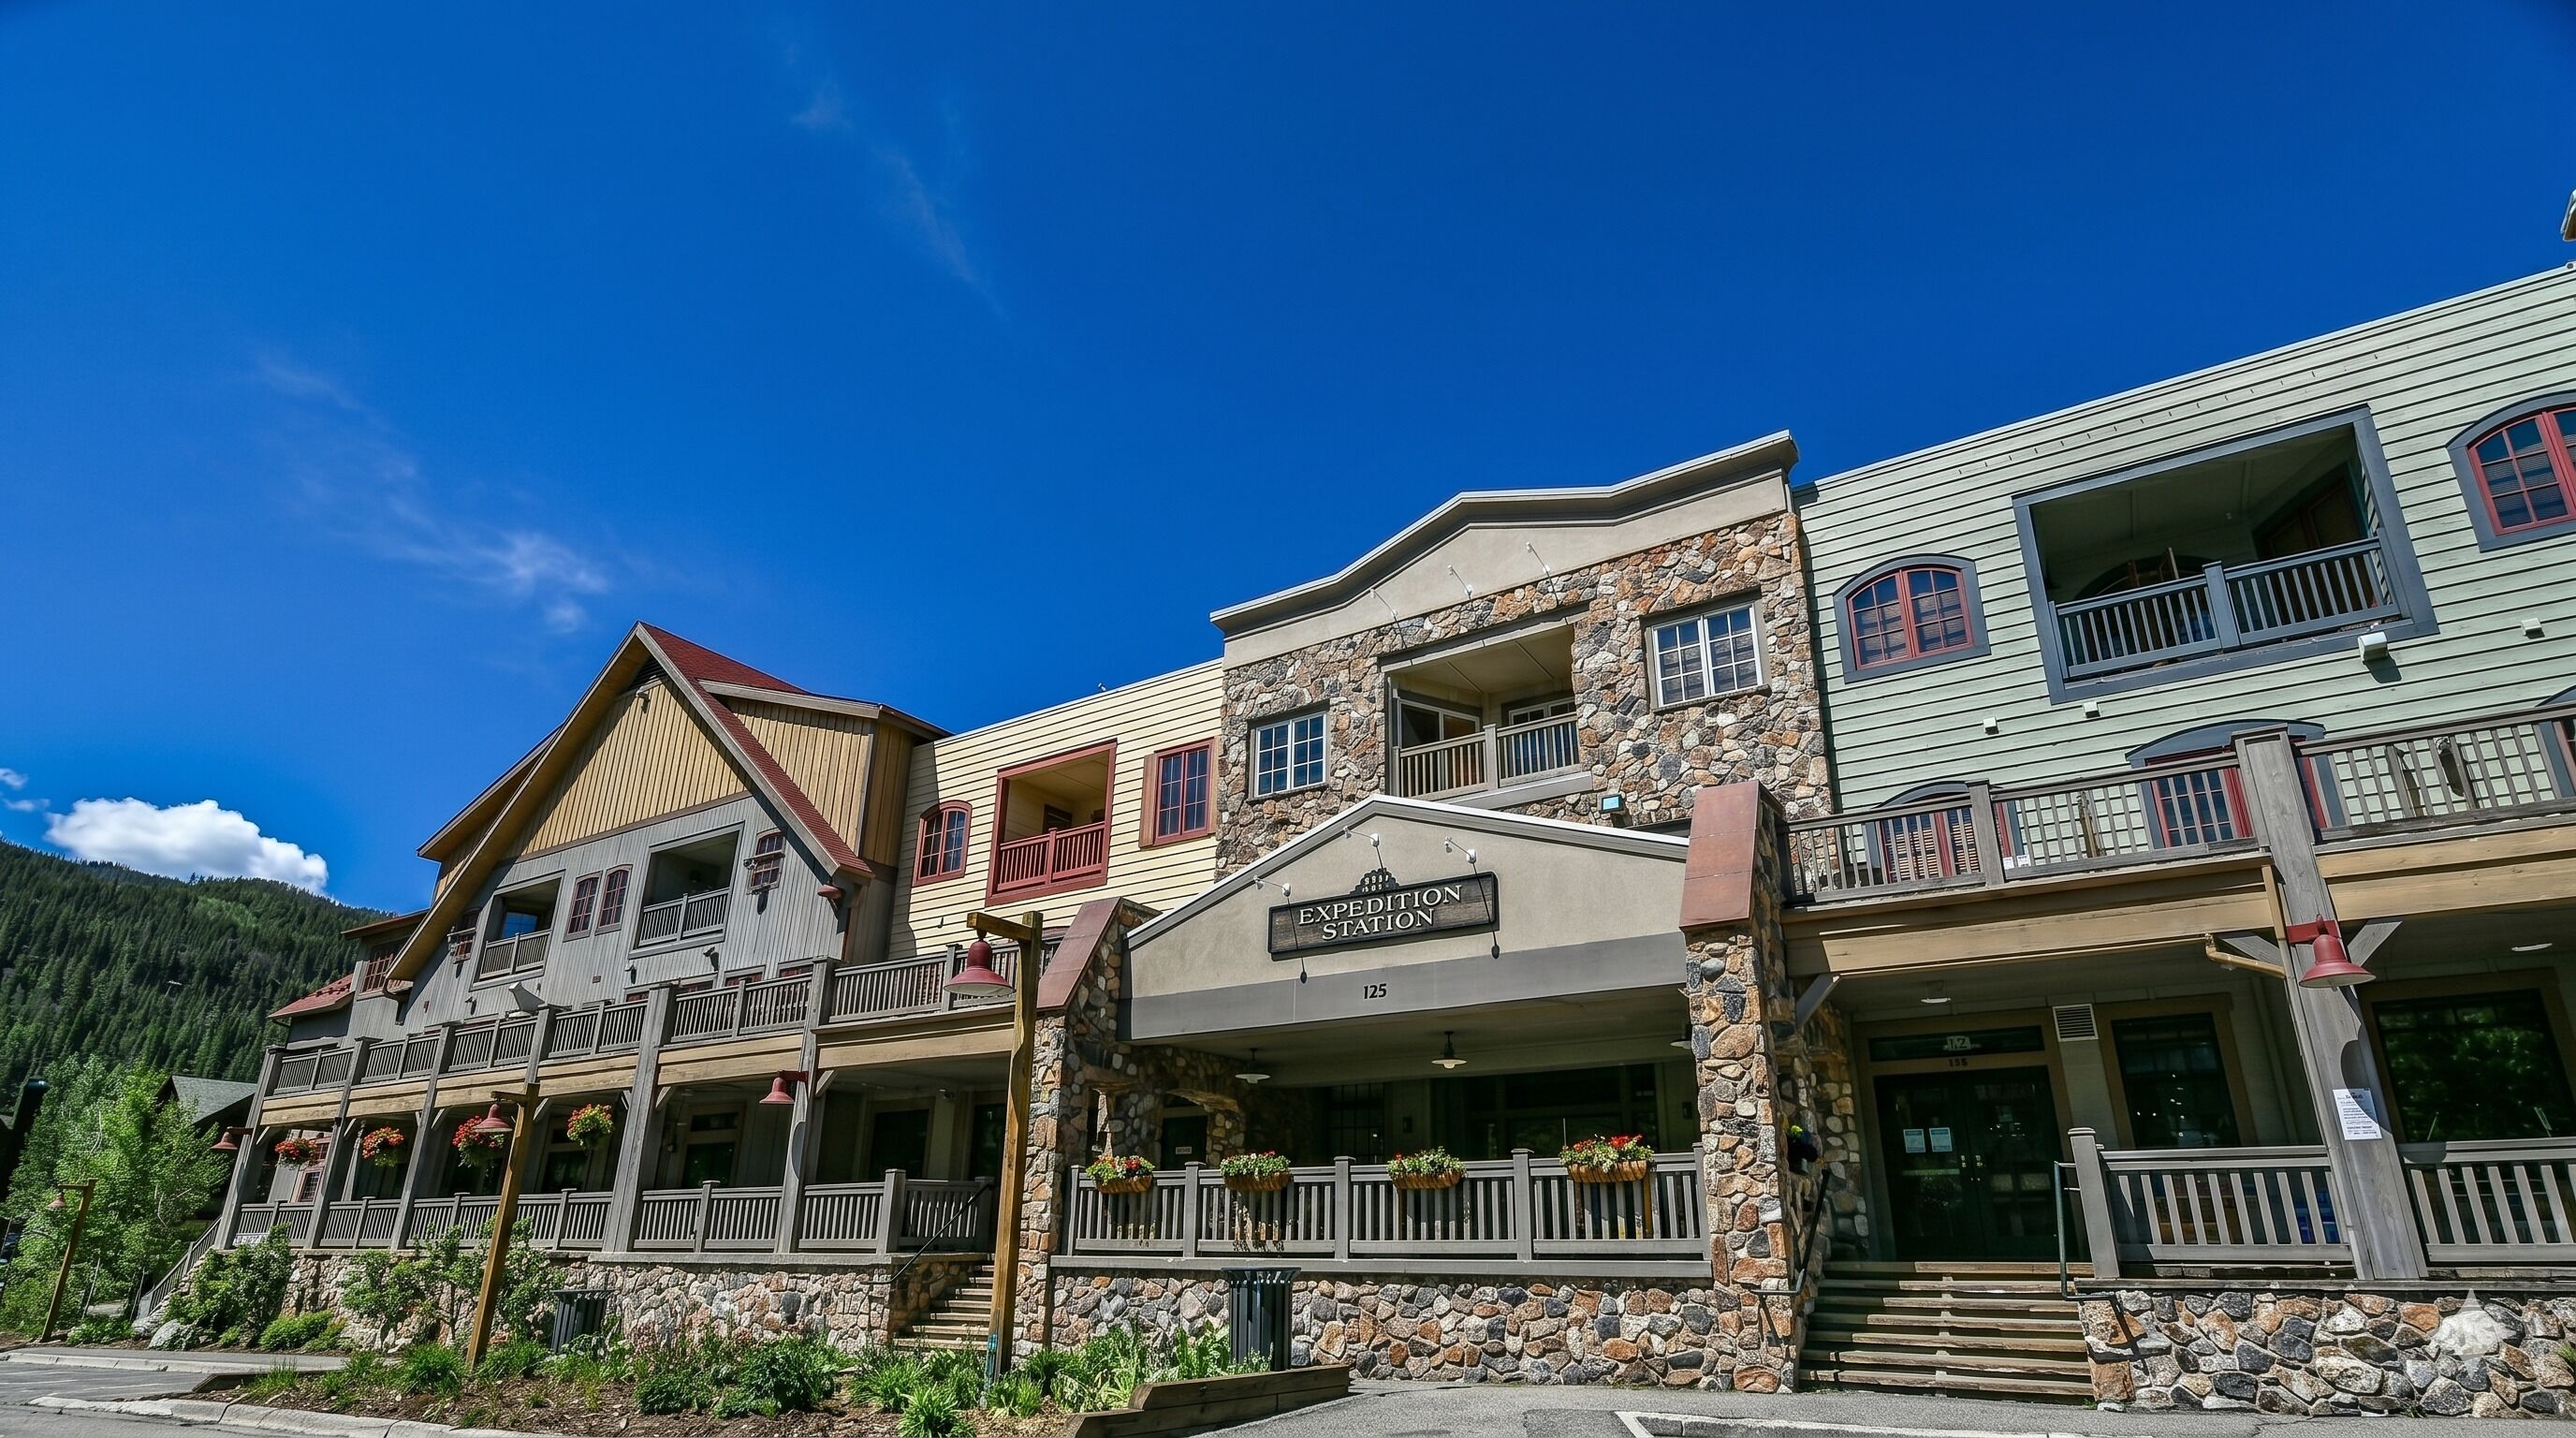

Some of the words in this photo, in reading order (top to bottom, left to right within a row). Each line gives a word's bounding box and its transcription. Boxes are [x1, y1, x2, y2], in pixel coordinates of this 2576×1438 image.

[1298, 885, 1462, 925] EXPEDITION
[1322, 908, 1435, 941] STATION
[1363, 983, 1387, 1000] 125
